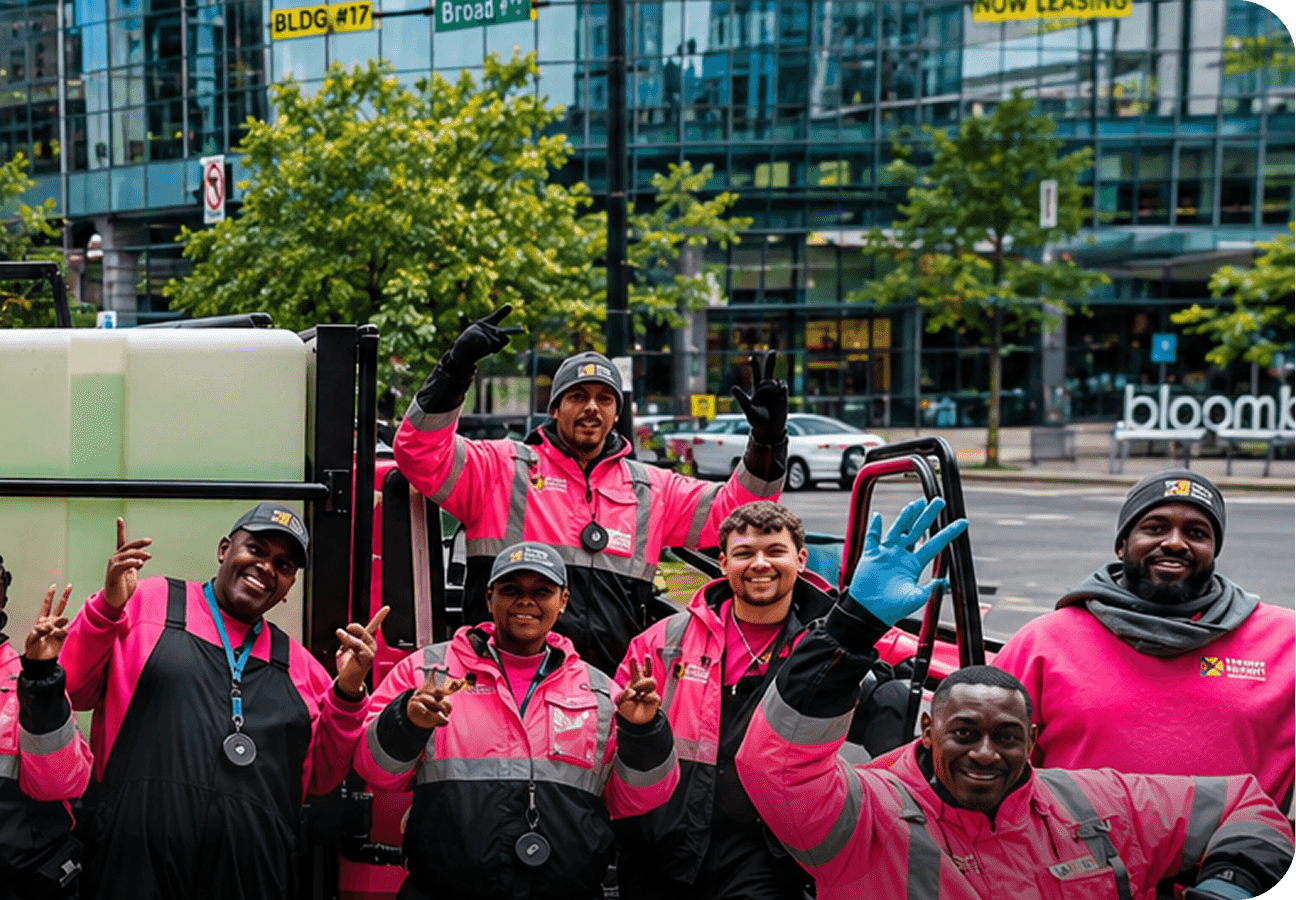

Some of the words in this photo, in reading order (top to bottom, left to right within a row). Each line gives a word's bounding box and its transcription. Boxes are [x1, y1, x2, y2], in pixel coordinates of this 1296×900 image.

[275, 9, 327, 32] BLDG
[336, 4, 369, 25] #17
[442, 0, 494, 23] Broad
